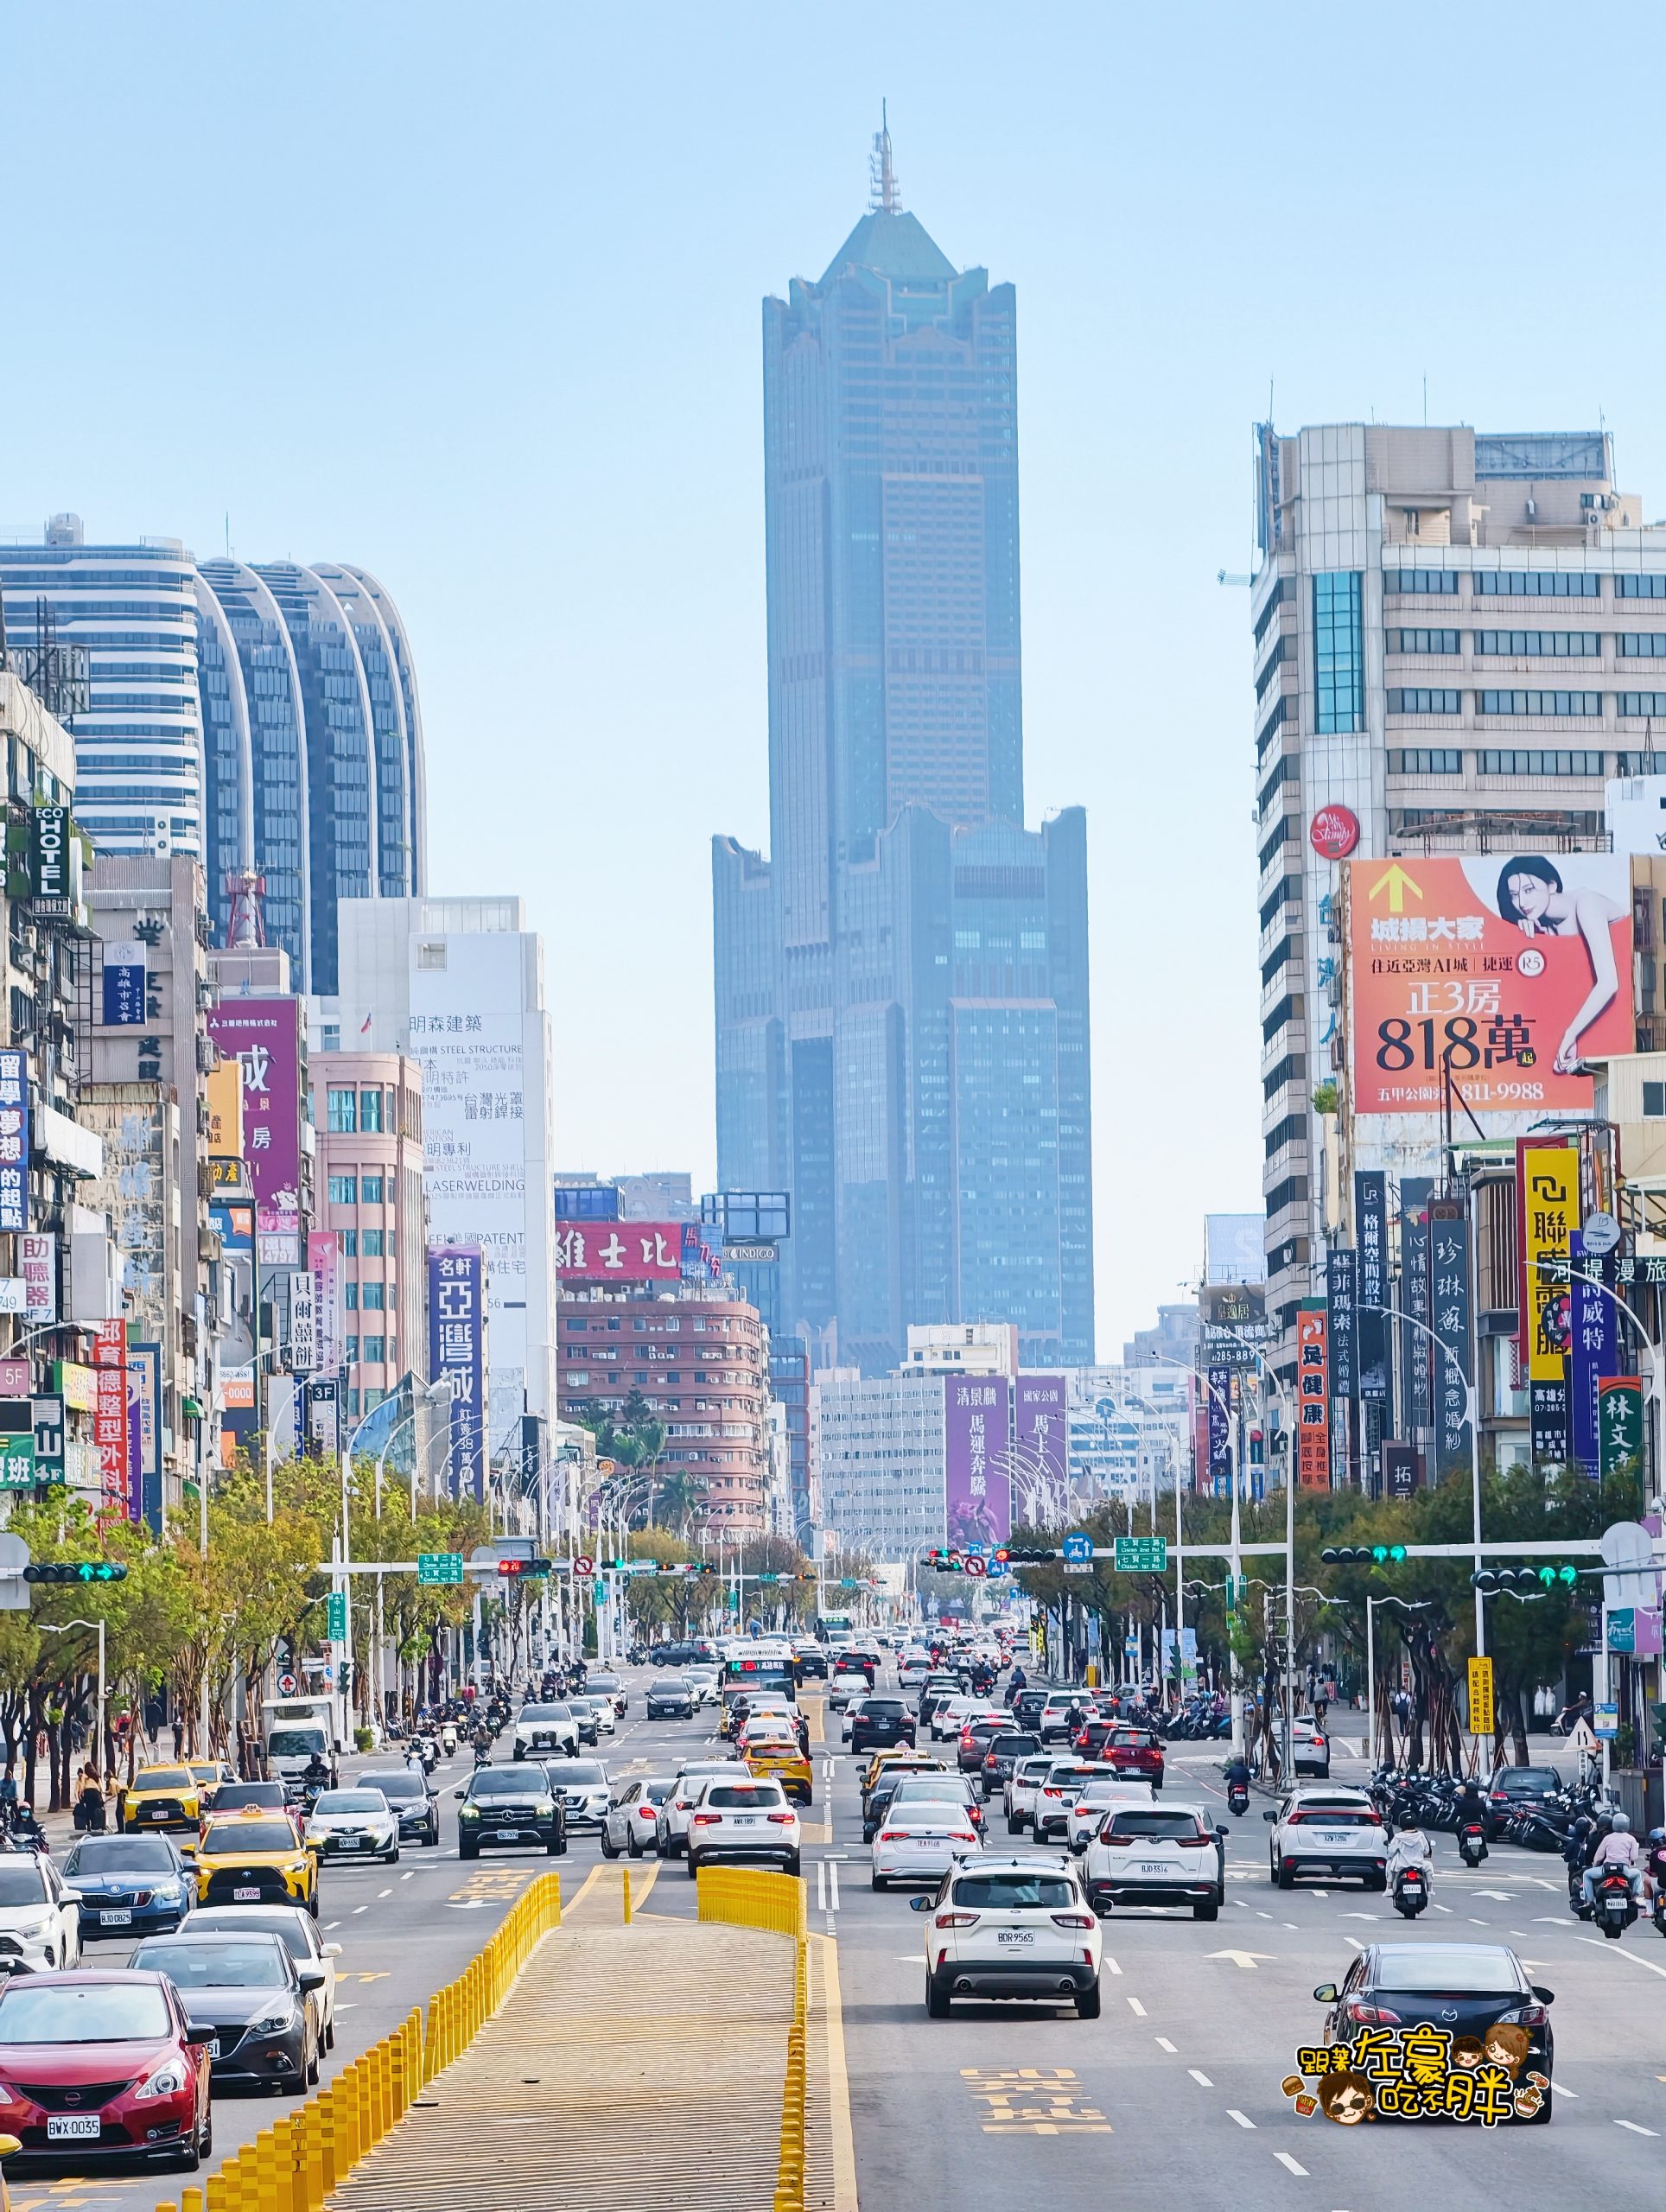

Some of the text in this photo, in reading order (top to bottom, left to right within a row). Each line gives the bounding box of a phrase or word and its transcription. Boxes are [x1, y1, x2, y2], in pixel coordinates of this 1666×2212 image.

[35, 808, 64, 819] ECO
[40, 820, 61, 894] HOTEL
[1370, 916, 1485, 941] 城揚大家
[1482, 955, 1514, 973] 捷運
[1523, 956, 1542, 969] R5
[1405, 978, 1502, 1015] 正3房
[409, 1014, 482, 1033] 明森建築
[440, 1046, 466, 1054] STEEL
[468, 1045, 523, 1054] STRUCTURE
[1376, 1014, 1536, 1071] 818萬
[0, 1054, 22, 1229] 留學夢想的起點
[251, 1126, 272, 1150] 房
[425, 1179, 525, 1192] LASERWELDING
[477, 1232, 525, 1245] PATENT
[556, 1229, 677, 1268] 維士比
[739, 1246, 774, 1259] INDIGO
[22, 1237, 49, 1306] 助聽器
[438, 1258, 472, 1277] 名軒
[1551, 1257, 1666, 1283] 河堤漫旅
[439, 1281, 474, 1404] 亞灣城
[5, 1368, 23, 1385] 5F
[1302, 1344, 1324, 1425] 足健康
[315, 1386, 333, 1399] 3F
[99, 1320, 124, 1495] 邱育德整型外科
[969, 1414, 987, 1497] 馬運奔騰
[0, 1455, 30, 1484] 班
[35, 1463, 62, 1481] 4F
[49, 2119, 99, 2138] BWX-0035
